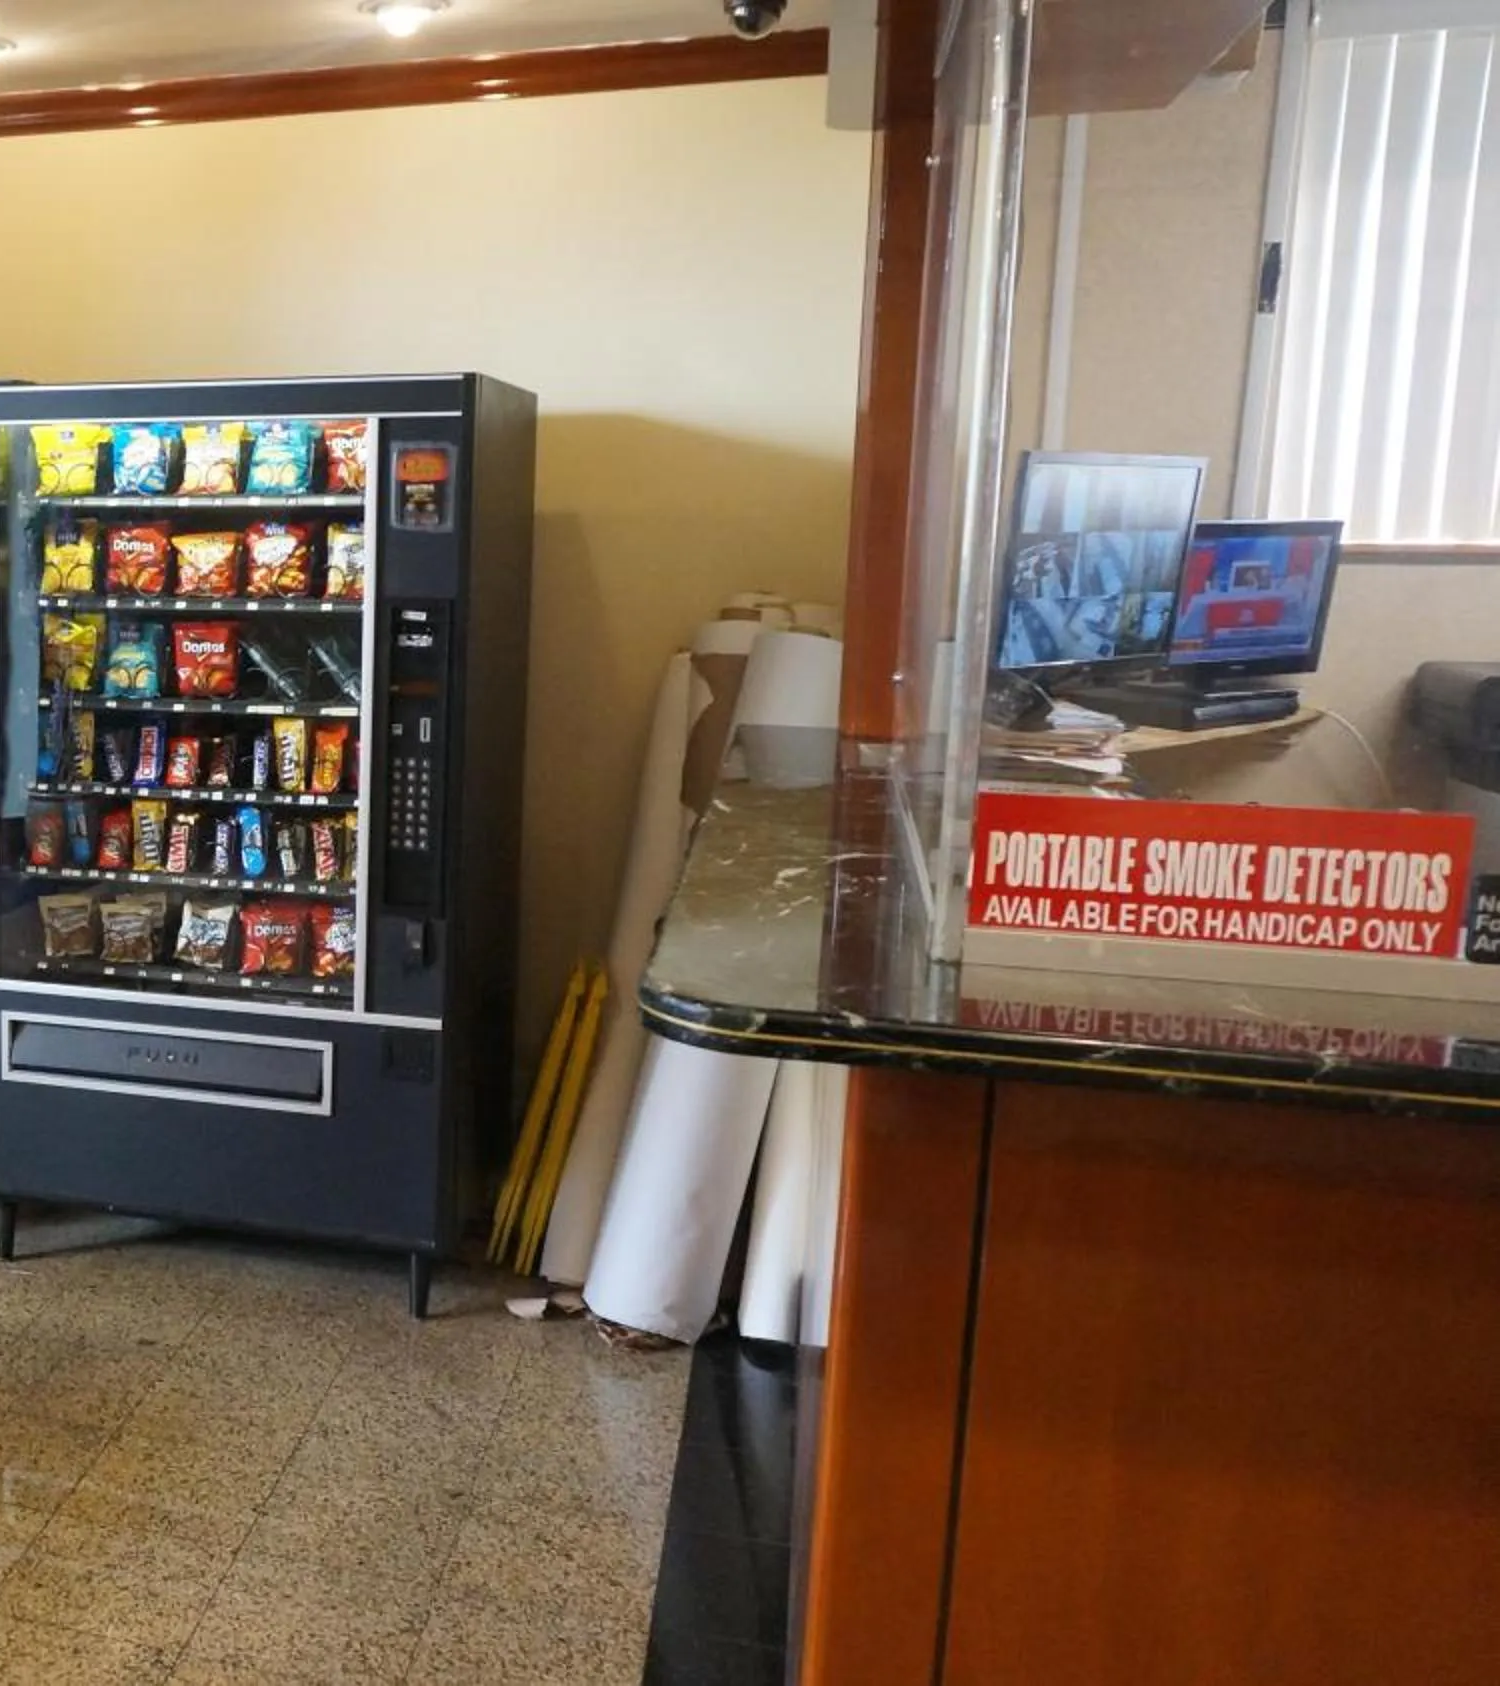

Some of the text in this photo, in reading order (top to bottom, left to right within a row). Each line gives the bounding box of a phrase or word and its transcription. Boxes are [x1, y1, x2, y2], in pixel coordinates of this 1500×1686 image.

[182, 640, 225, 653] Doritos
[985, 831, 1453, 913] PORTABLE SMOKE DETECTORS
[983, 895, 1442, 953] AVAILABLE FOR HANDICAP ONLY
